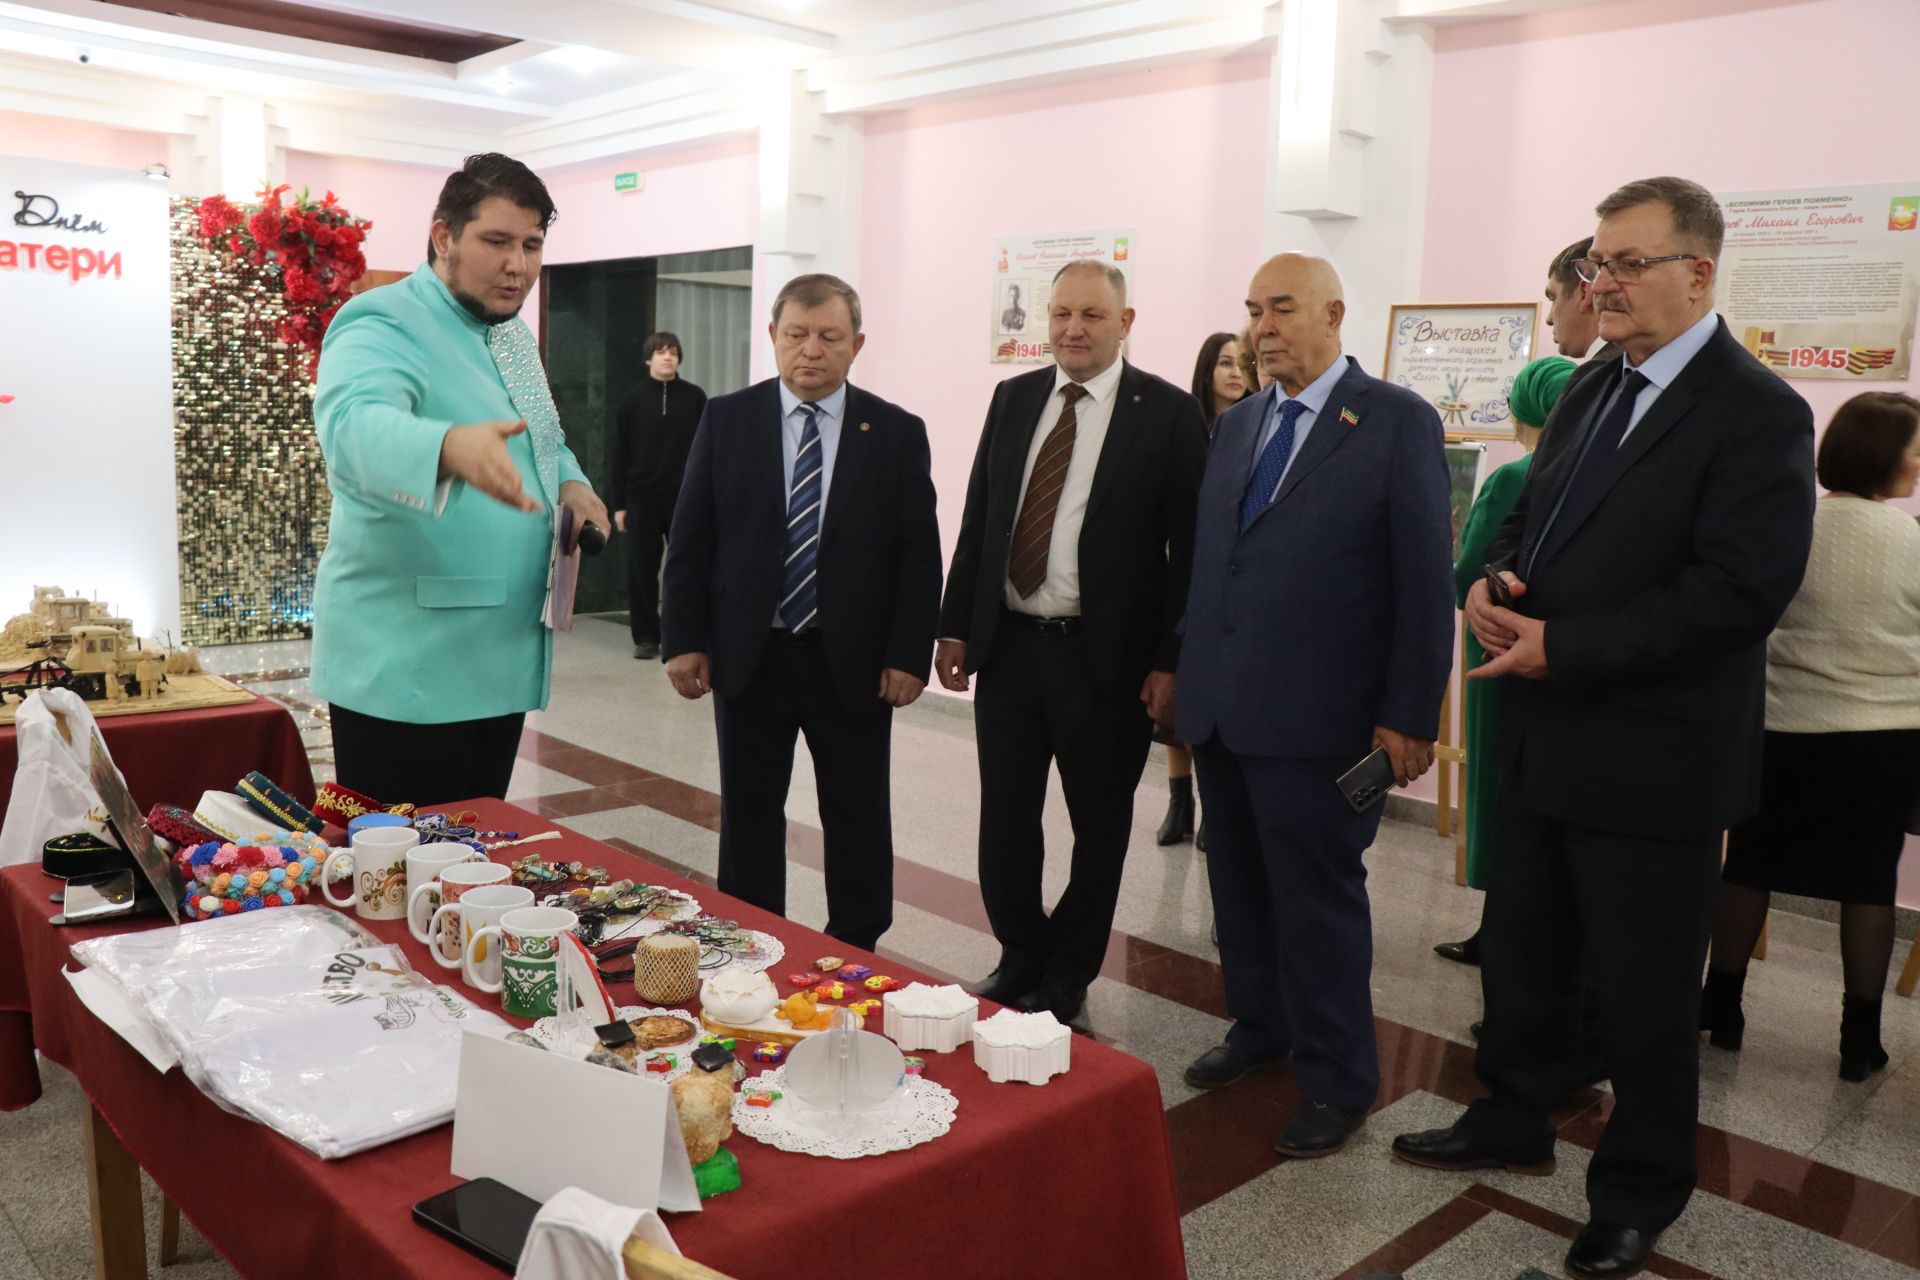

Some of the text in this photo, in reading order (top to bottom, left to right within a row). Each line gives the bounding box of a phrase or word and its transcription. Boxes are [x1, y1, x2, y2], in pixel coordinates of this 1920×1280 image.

[1745, 216, 1799, 228] Михаил
[1806, 212, 1864, 229] Егорович
[0, 240, 122, 281] атери
[1413, 320, 1500, 343] Выставка
[1016, 343, 1043, 357] 1941
[1790, 348, 1848, 369] 1945
